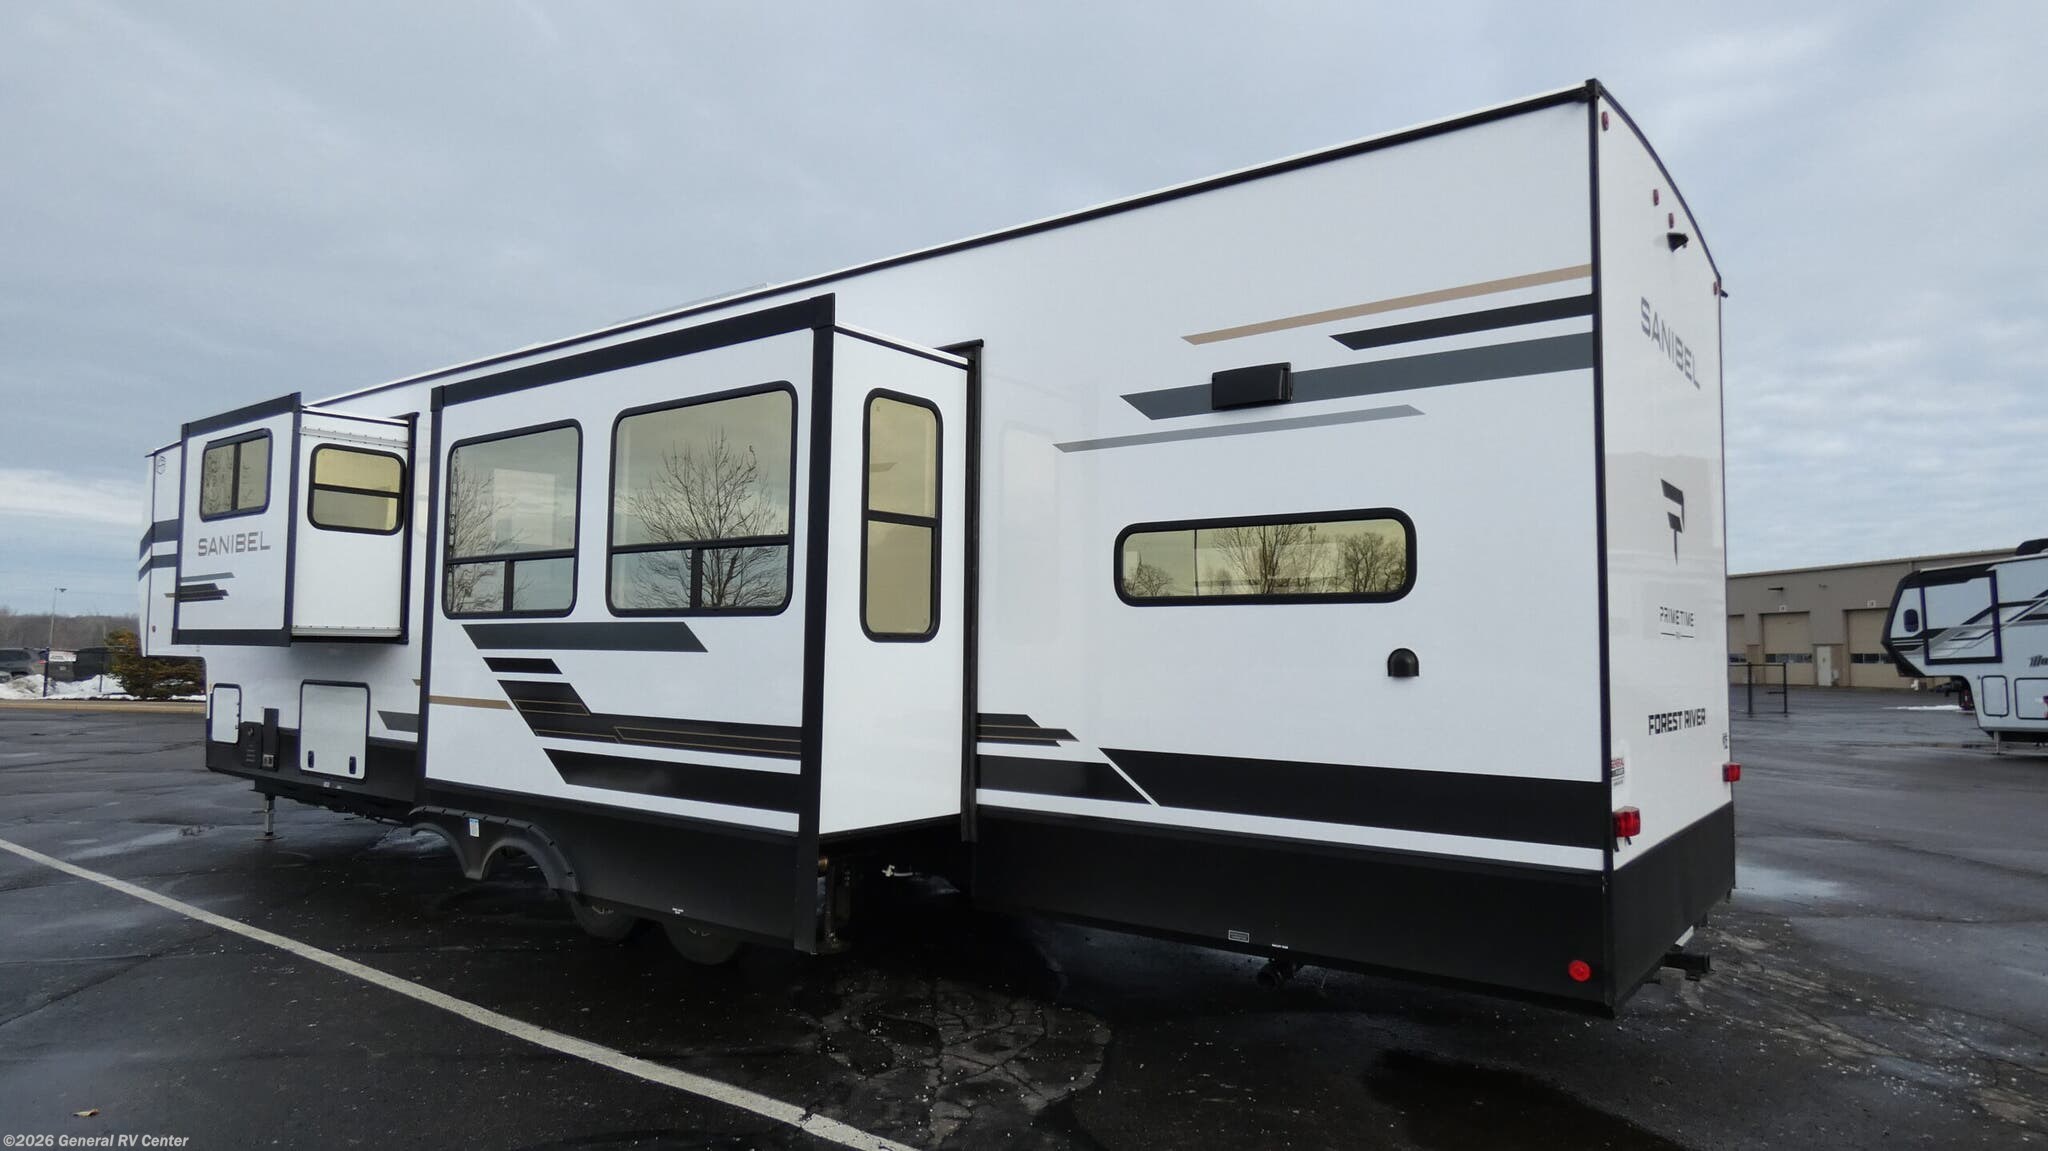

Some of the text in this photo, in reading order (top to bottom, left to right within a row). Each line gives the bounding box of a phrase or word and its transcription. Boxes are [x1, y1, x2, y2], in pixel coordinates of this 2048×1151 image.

[1641, 296, 1700, 389] SANIBEL
[198, 531, 271, 557] SANIBEL
[1648, 708, 1706, 735] FOREST RIVER
